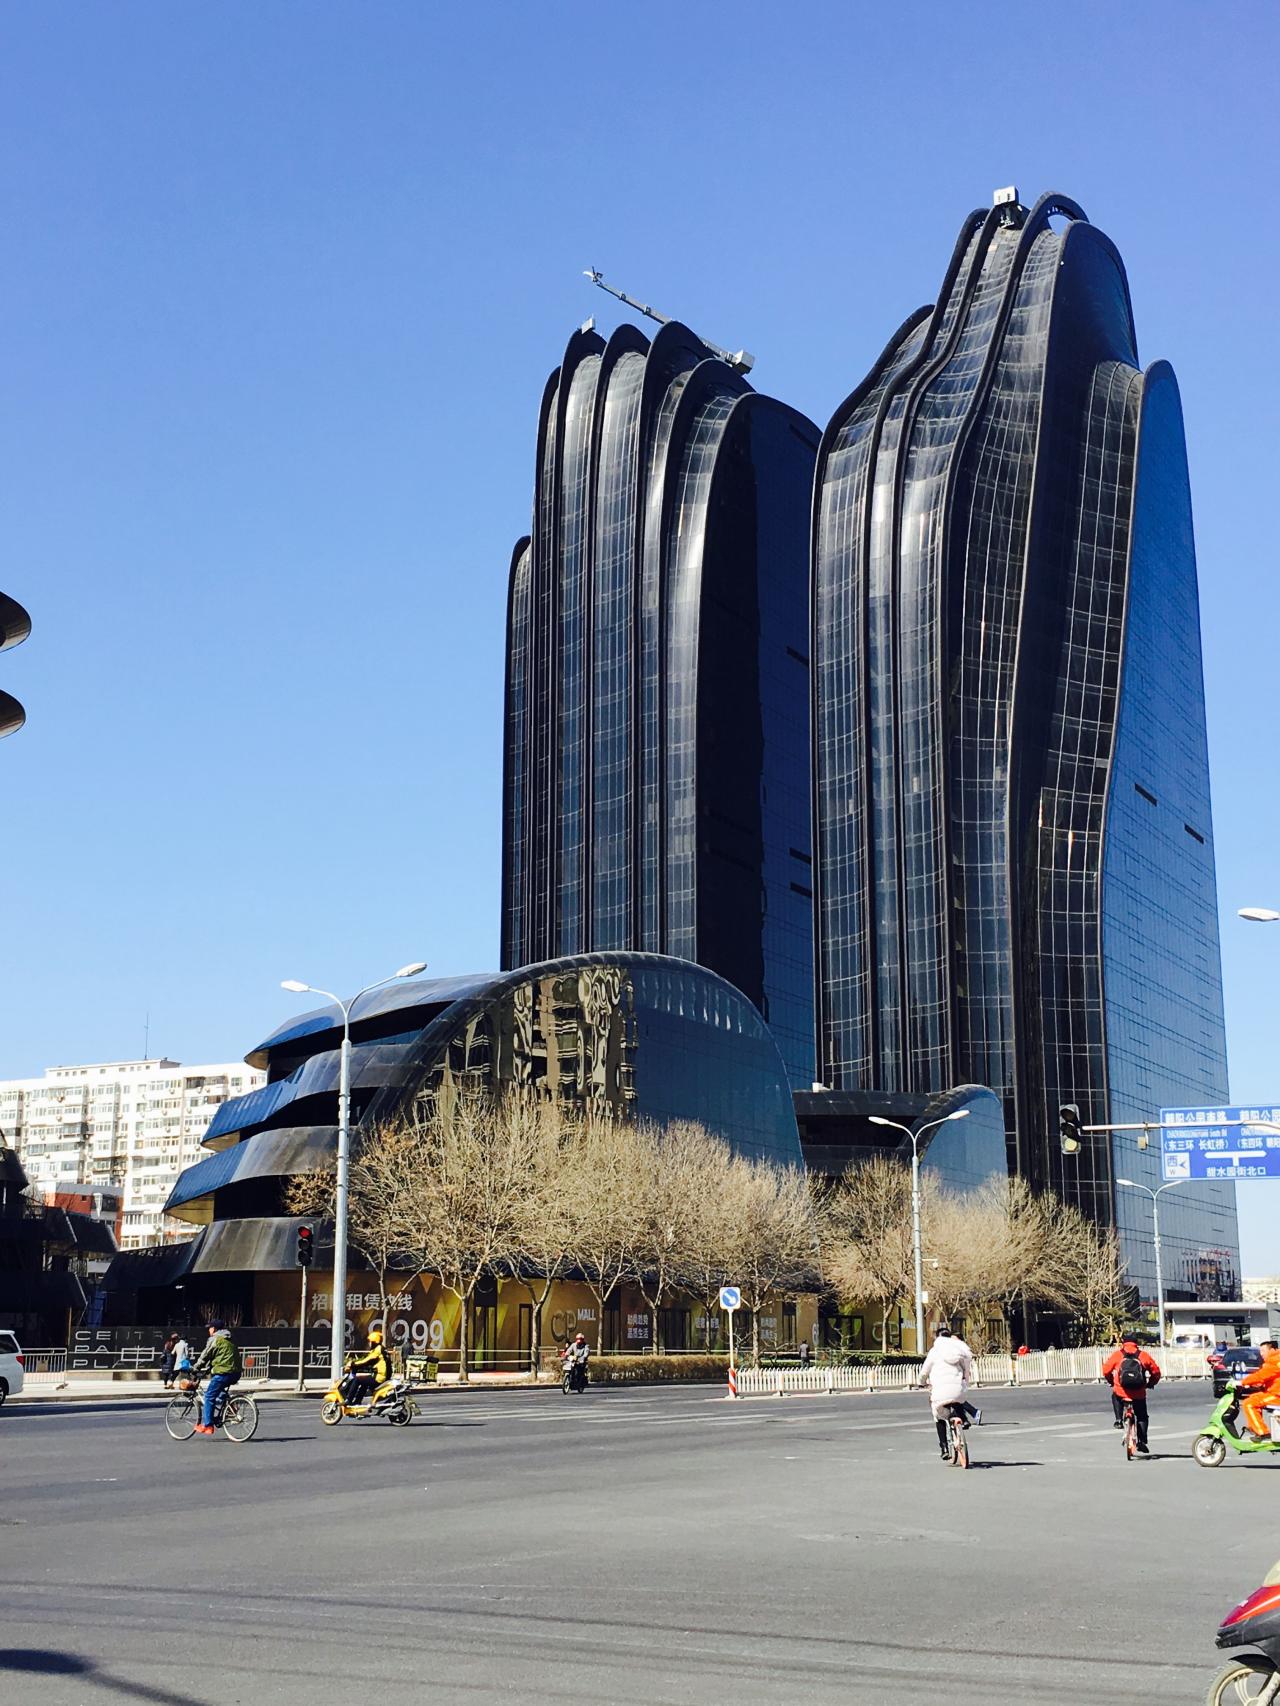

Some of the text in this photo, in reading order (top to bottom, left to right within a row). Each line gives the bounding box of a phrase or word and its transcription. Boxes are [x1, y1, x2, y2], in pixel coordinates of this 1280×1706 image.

[311, 1293, 413, 1311] 招租赁热线
[578, 1309, 596, 1321] MALL
